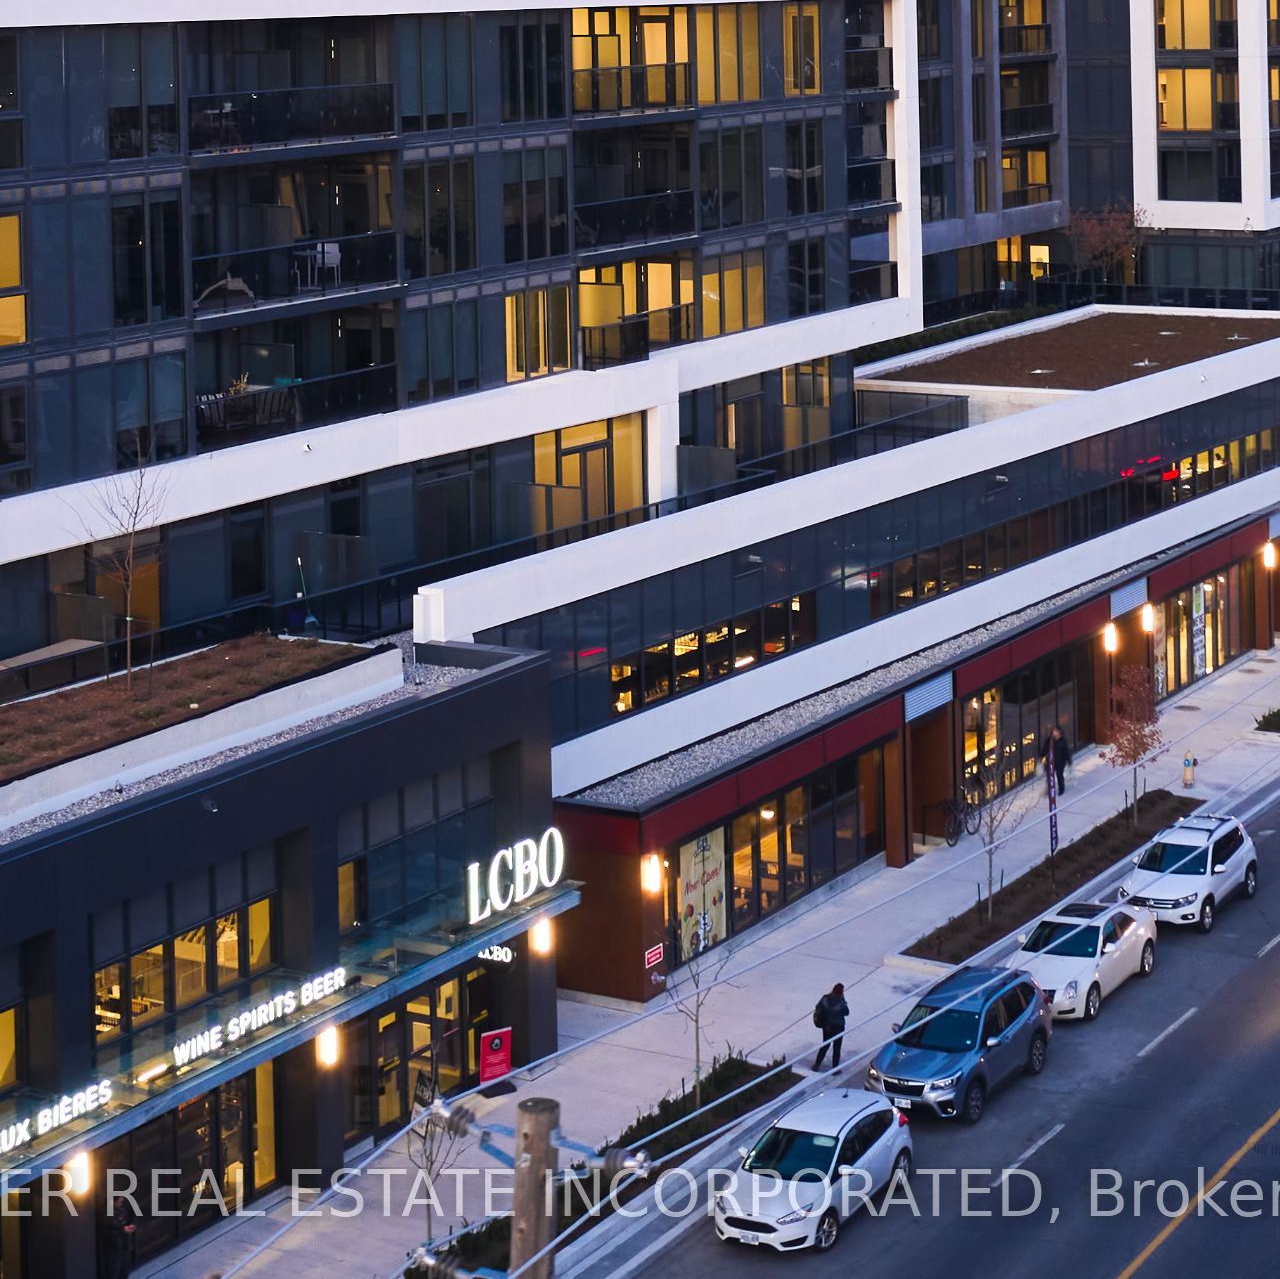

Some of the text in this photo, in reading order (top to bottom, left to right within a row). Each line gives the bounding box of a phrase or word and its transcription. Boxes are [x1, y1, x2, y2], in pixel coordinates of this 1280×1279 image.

[467, 827, 564, 924] LCBO
[173, 967, 346, 1066] WINE SPIRITS BEER
[37, 1079, 113, 1135] BIÈRES
